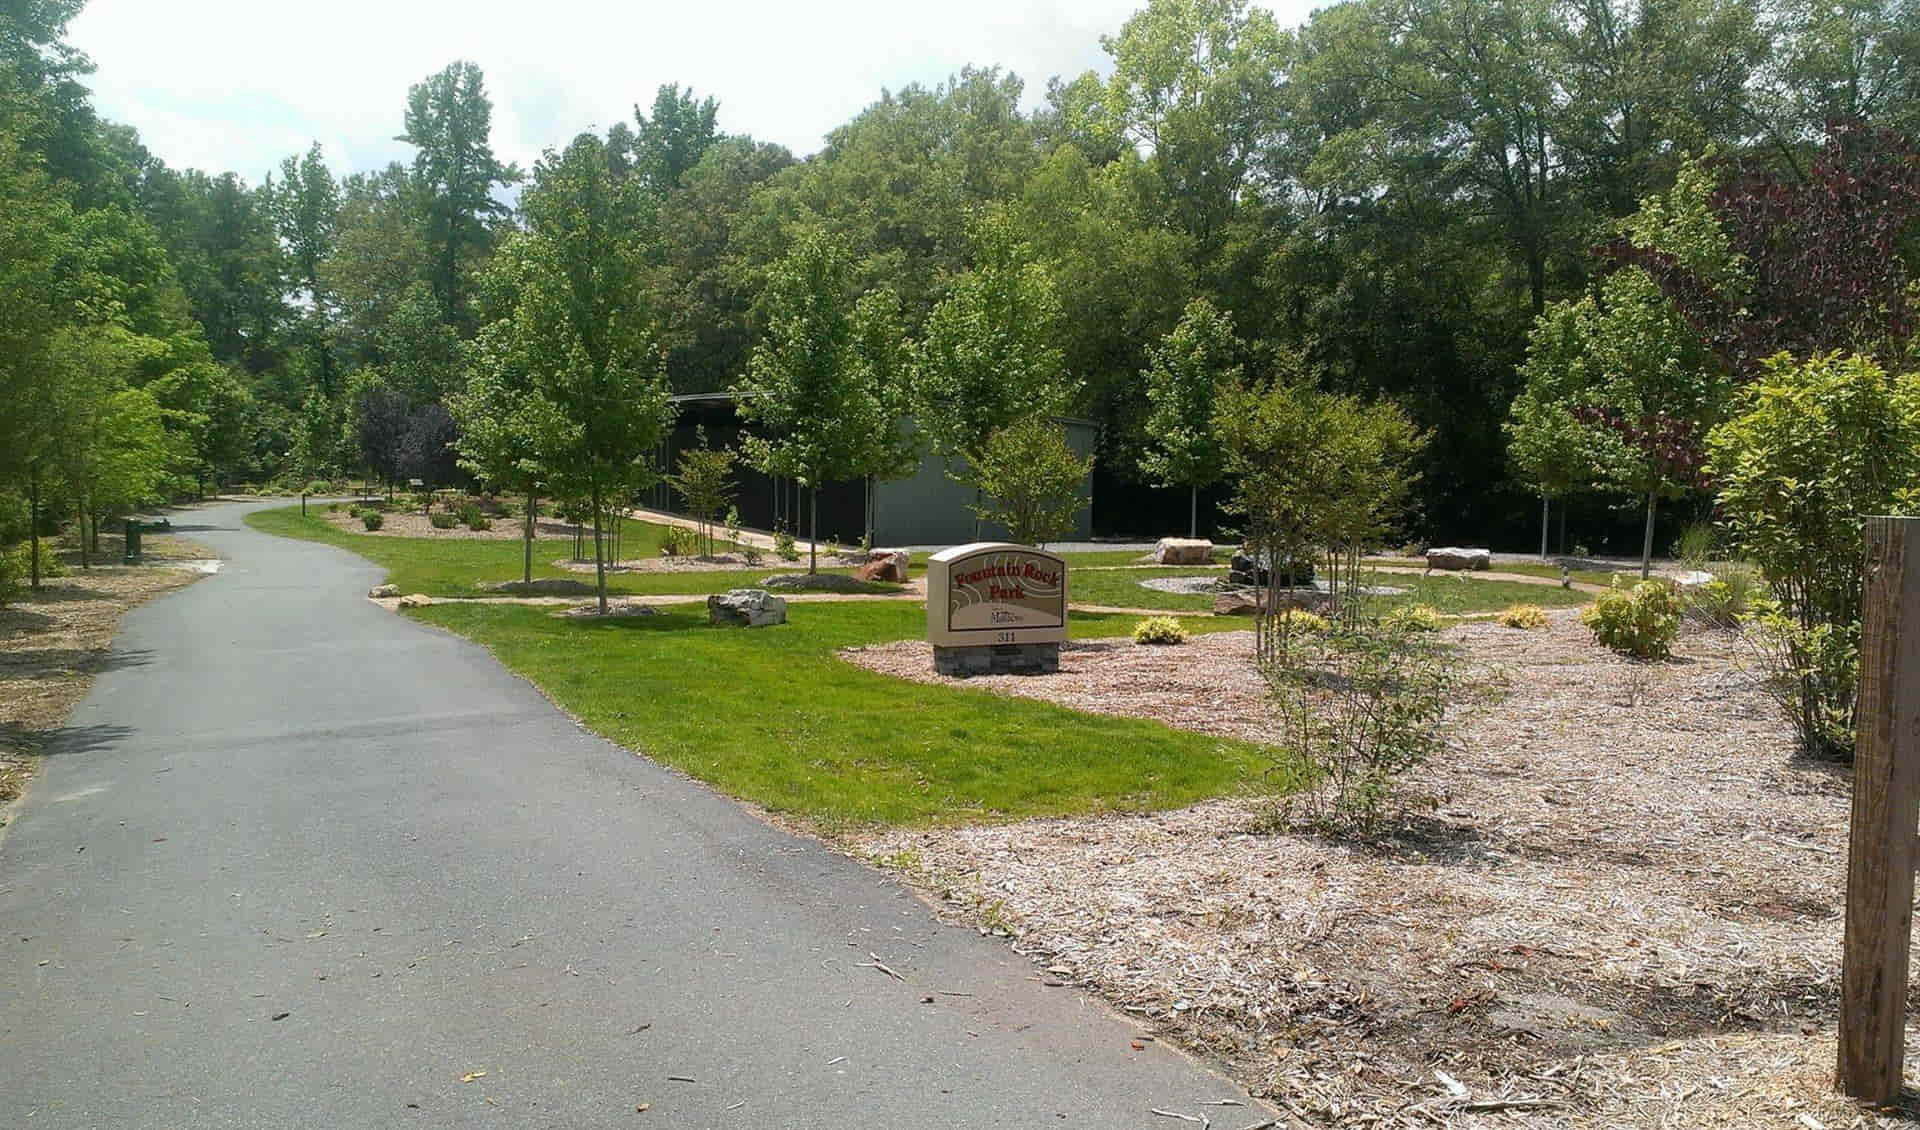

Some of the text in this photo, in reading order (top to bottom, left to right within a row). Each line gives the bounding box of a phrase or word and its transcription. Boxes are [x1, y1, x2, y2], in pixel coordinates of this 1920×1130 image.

[955, 562, 1057, 585] Fountain Rock
[990, 585, 1024, 599] Park
[998, 631, 1015, 642] 311
